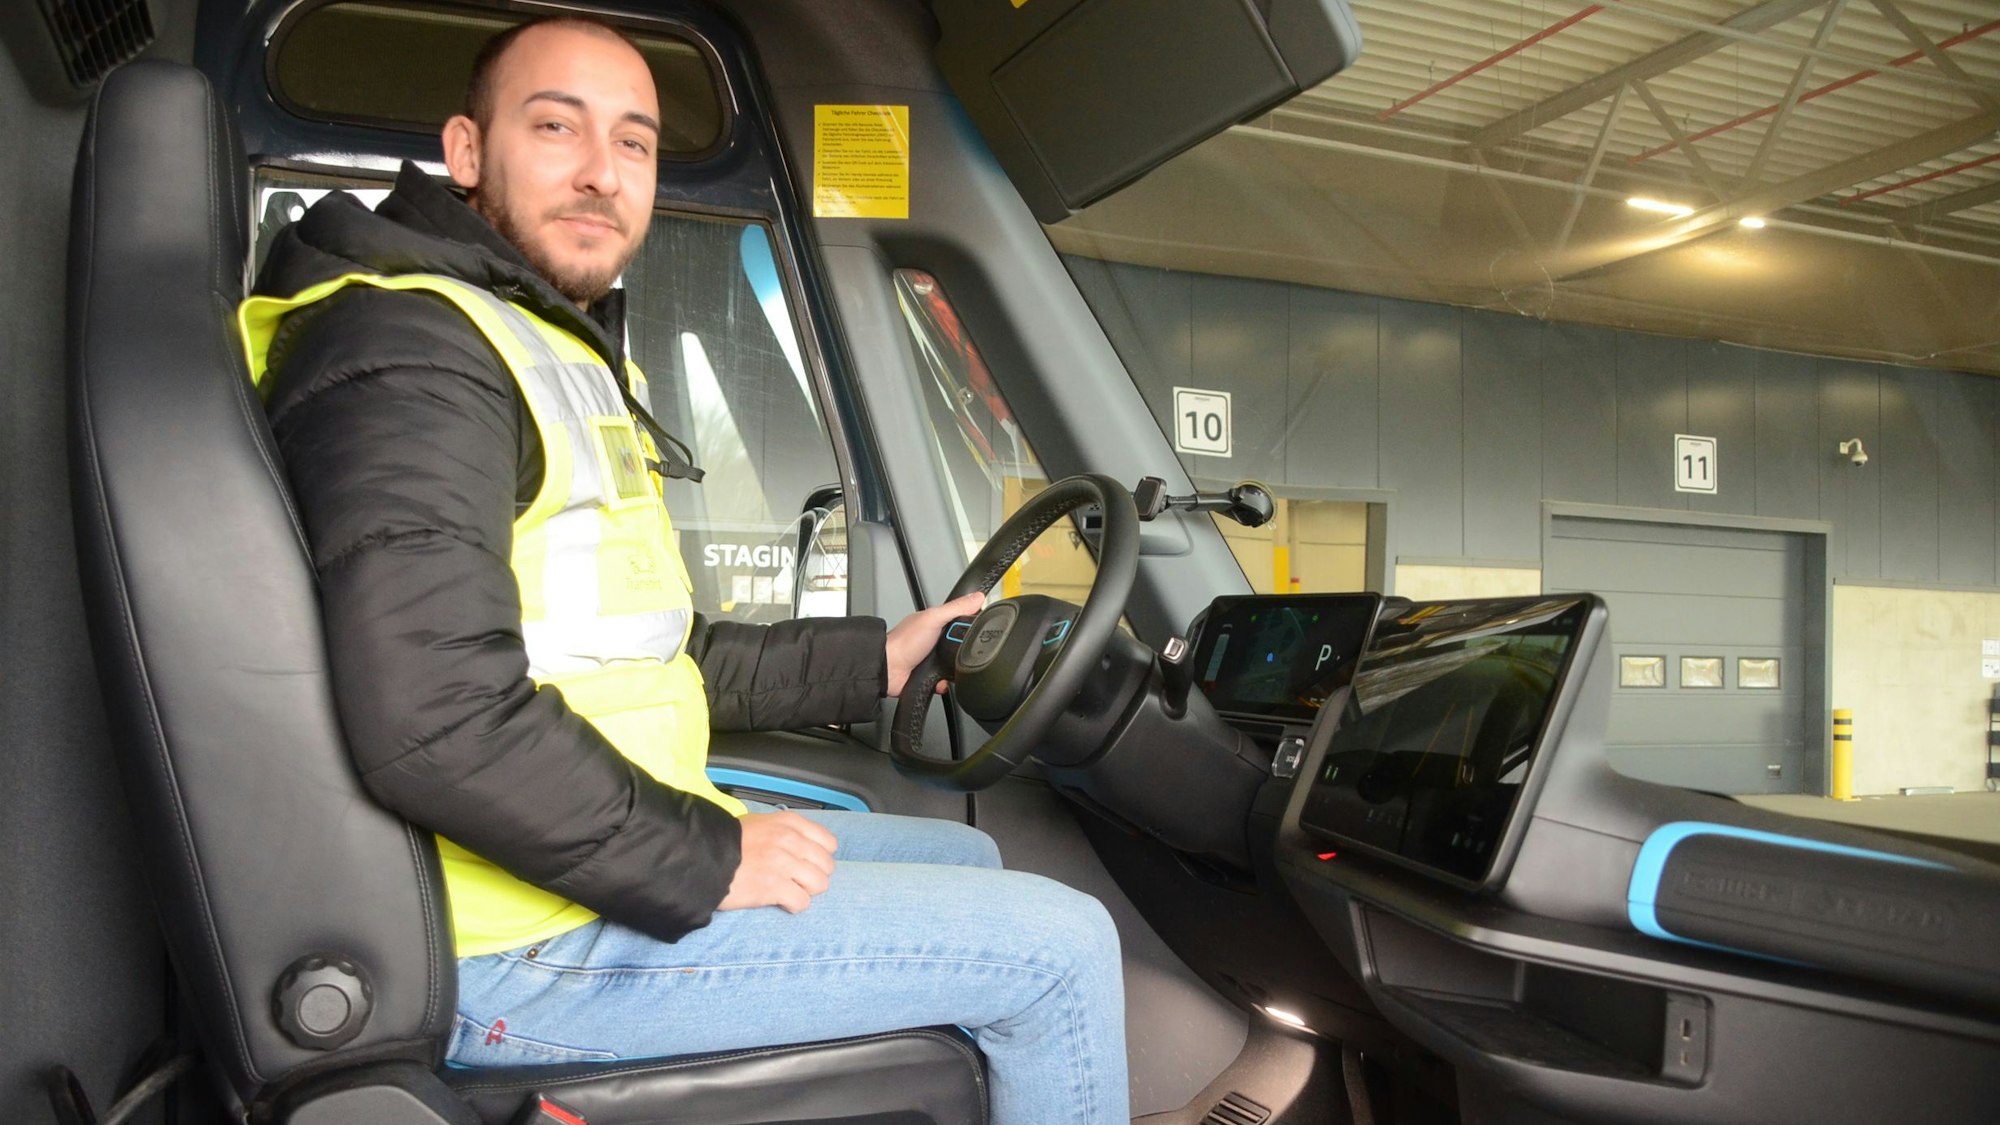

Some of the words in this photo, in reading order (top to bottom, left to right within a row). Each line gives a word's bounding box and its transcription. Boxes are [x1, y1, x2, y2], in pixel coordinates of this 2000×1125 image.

[1185, 411, 1222, 441] 10
[1683, 454, 1707, 480] 11
[1315, 644, 1332, 671] P
